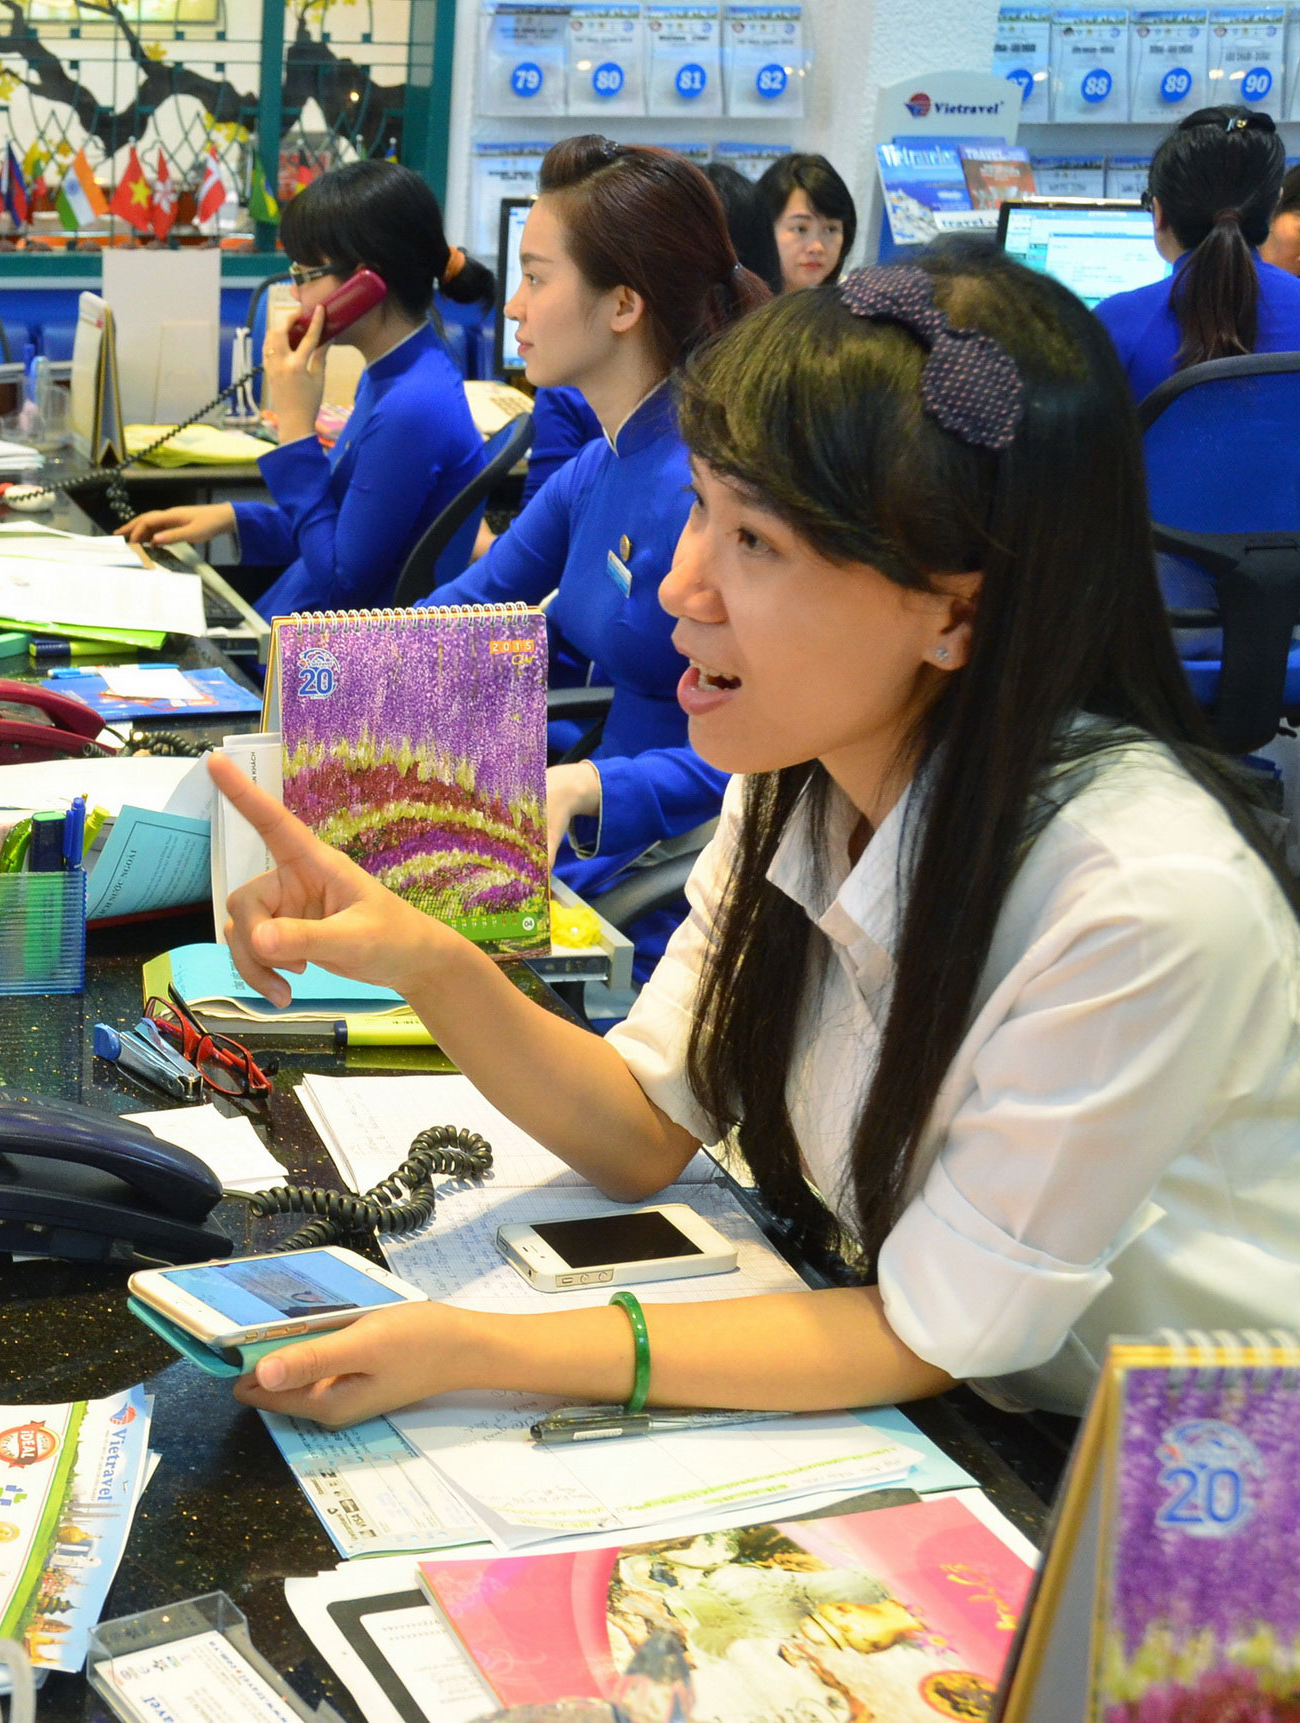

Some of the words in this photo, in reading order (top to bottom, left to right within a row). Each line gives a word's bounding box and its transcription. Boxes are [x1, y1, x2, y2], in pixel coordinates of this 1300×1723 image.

[516, 70, 540, 89] 79
[596, 70, 621, 90] 80
[680, 71, 701, 90] 81
[760, 71, 783, 90] 82
[1085, 77, 1108, 95] 88
[1165, 75, 1188, 93] 89
[1245, 74, 1269, 93] 90
[934, 102, 999, 115] Vietravel
[492, 641, 533, 652] 2015
[299, 668, 333, 695] 20
[97, 1427, 126, 1501] Vietravel
[1164, 1467, 1242, 1524] 20
[350, 1512, 366, 1529] VISA
